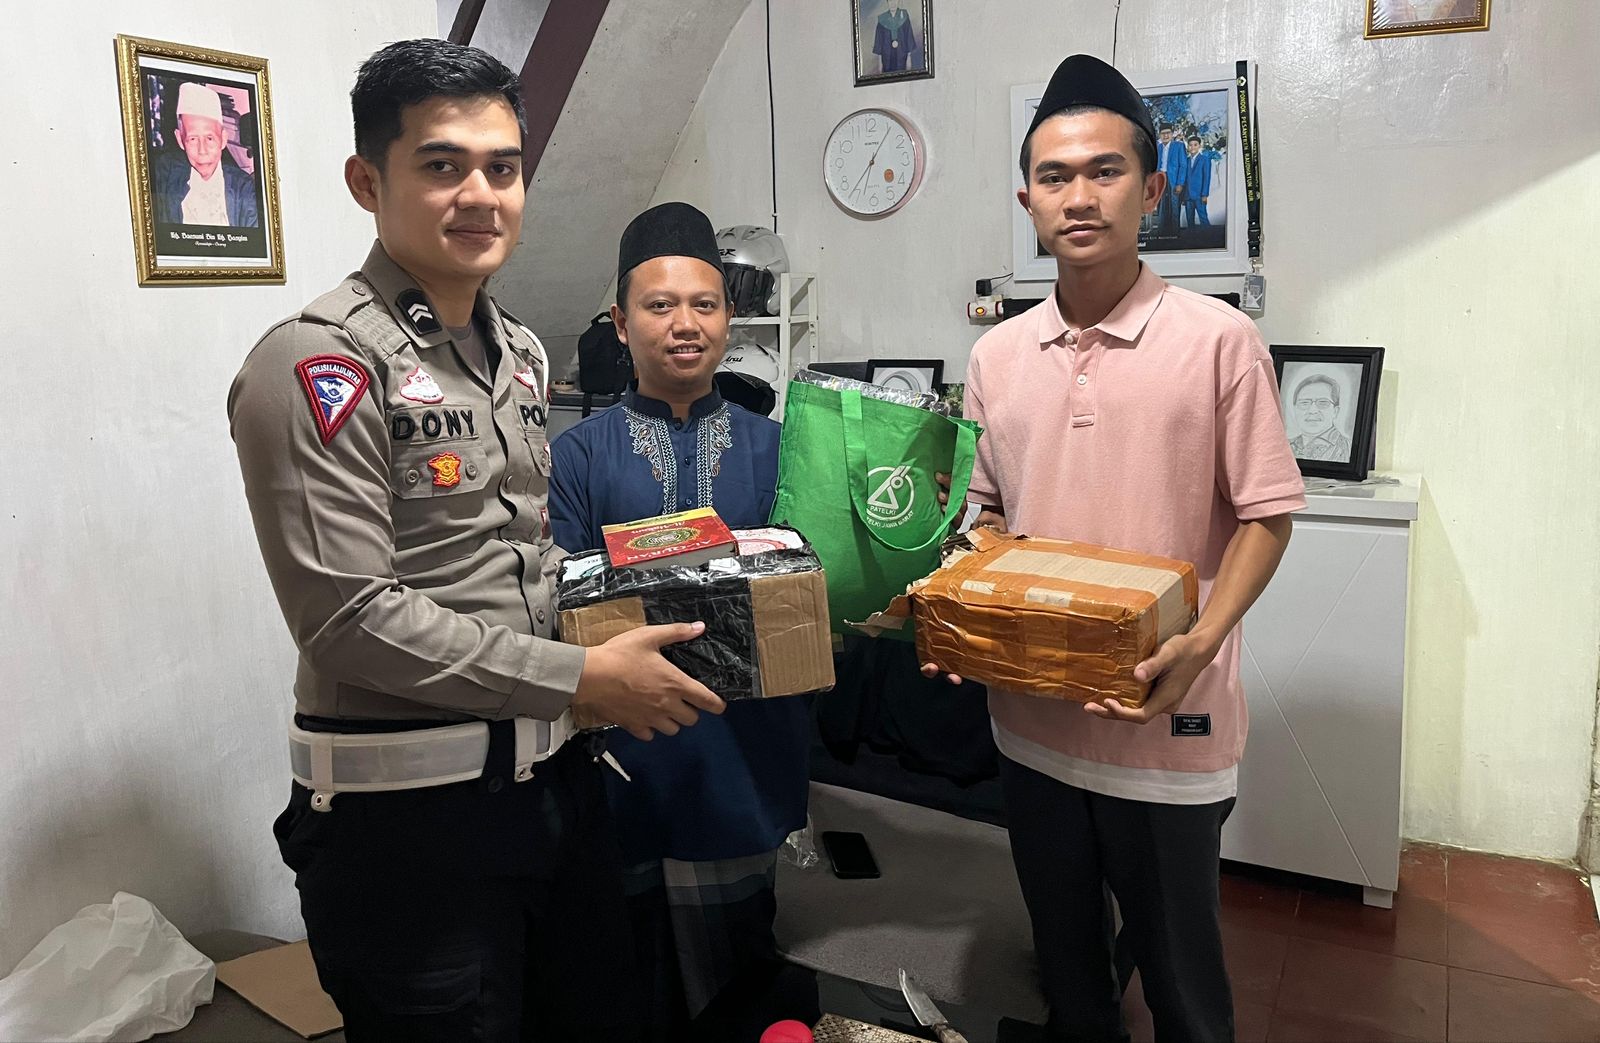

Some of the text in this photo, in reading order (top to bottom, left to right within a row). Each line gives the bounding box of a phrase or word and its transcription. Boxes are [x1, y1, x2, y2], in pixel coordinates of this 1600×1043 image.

[1239, 90, 1247, 113] PONDOK
[865, 118, 877, 133] 12
[308, 363, 330, 376] POLISI
[392, 408, 475, 441] DONY
[519, 404, 547, 429] POL
[869, 505, 897, 516] PATELKI
